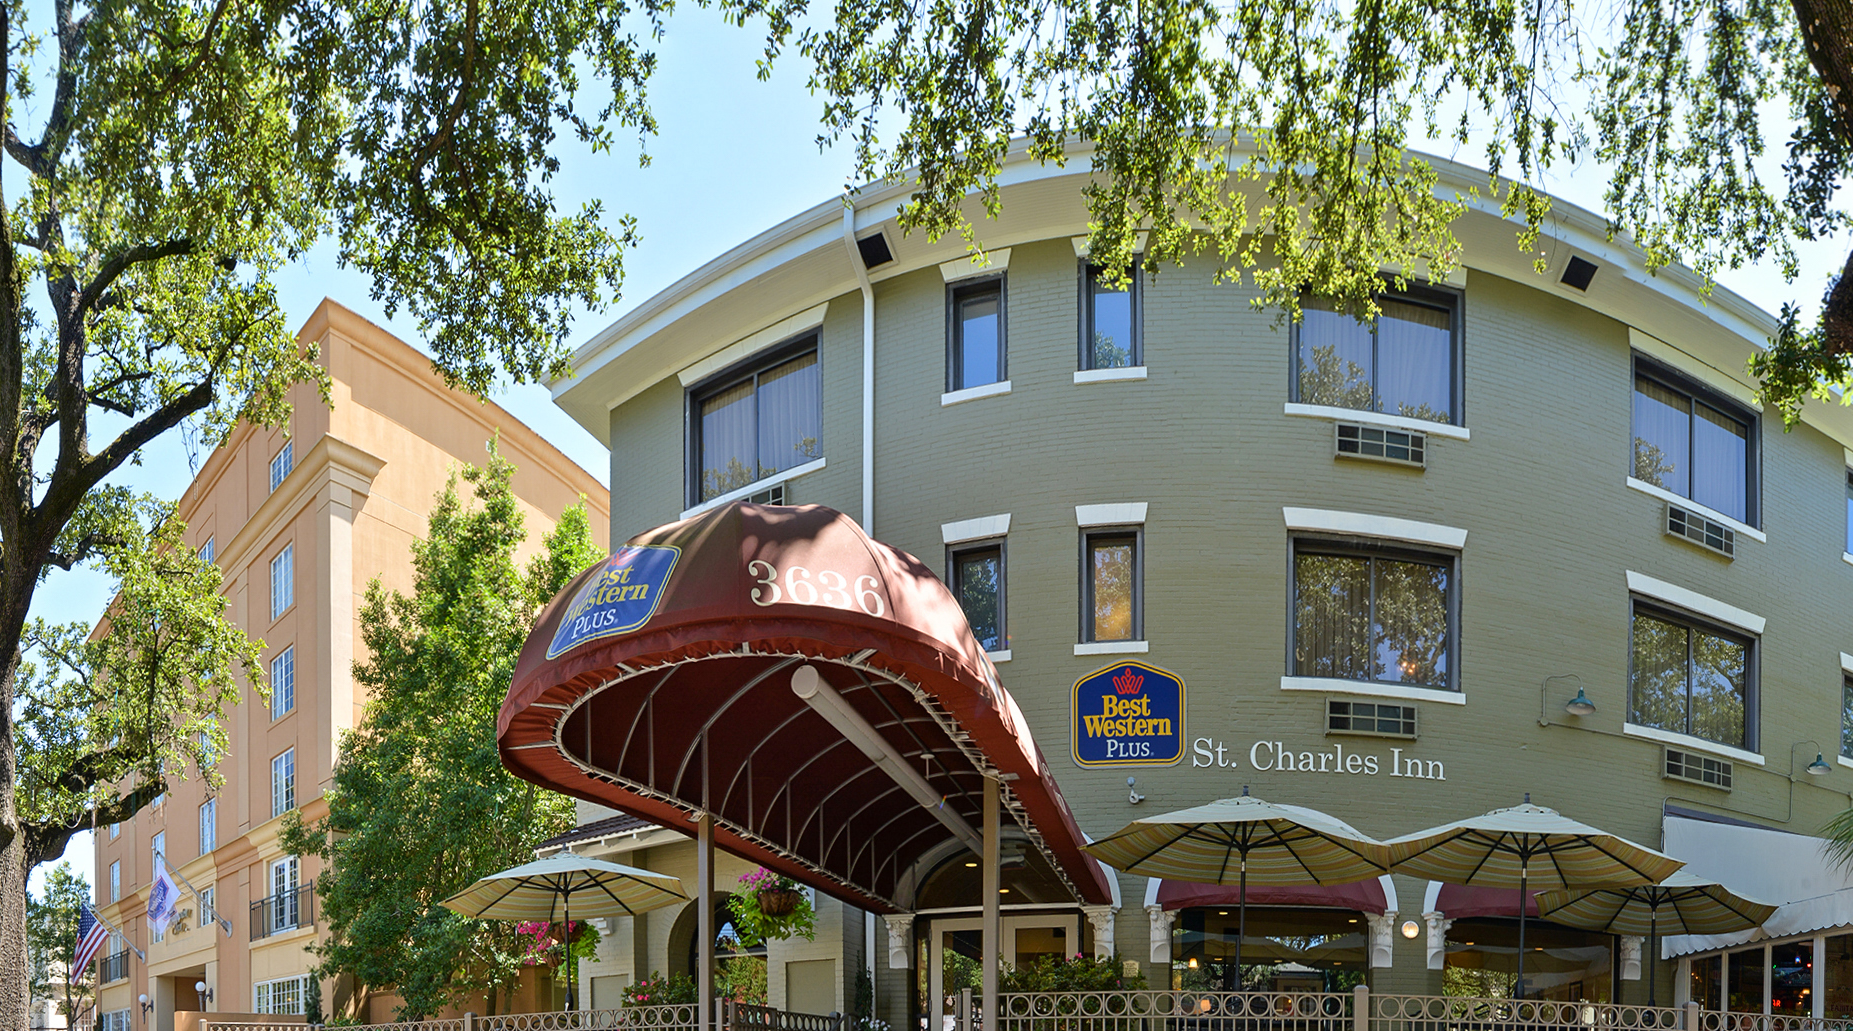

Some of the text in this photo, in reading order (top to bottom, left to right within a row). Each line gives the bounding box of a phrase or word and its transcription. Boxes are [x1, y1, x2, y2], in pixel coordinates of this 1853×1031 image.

[565, 578, 649, 627] Western
[748, 559, 885, 618] 3636
[571, 608, 617, 640] PLUS
[1101, 693, 1152, 719] Best
[1082, 710, 1173, 738] Western
[1105, 739, 1151, 758] PLUS
[1192, 737, 1447, 781] St. Charles Inn
